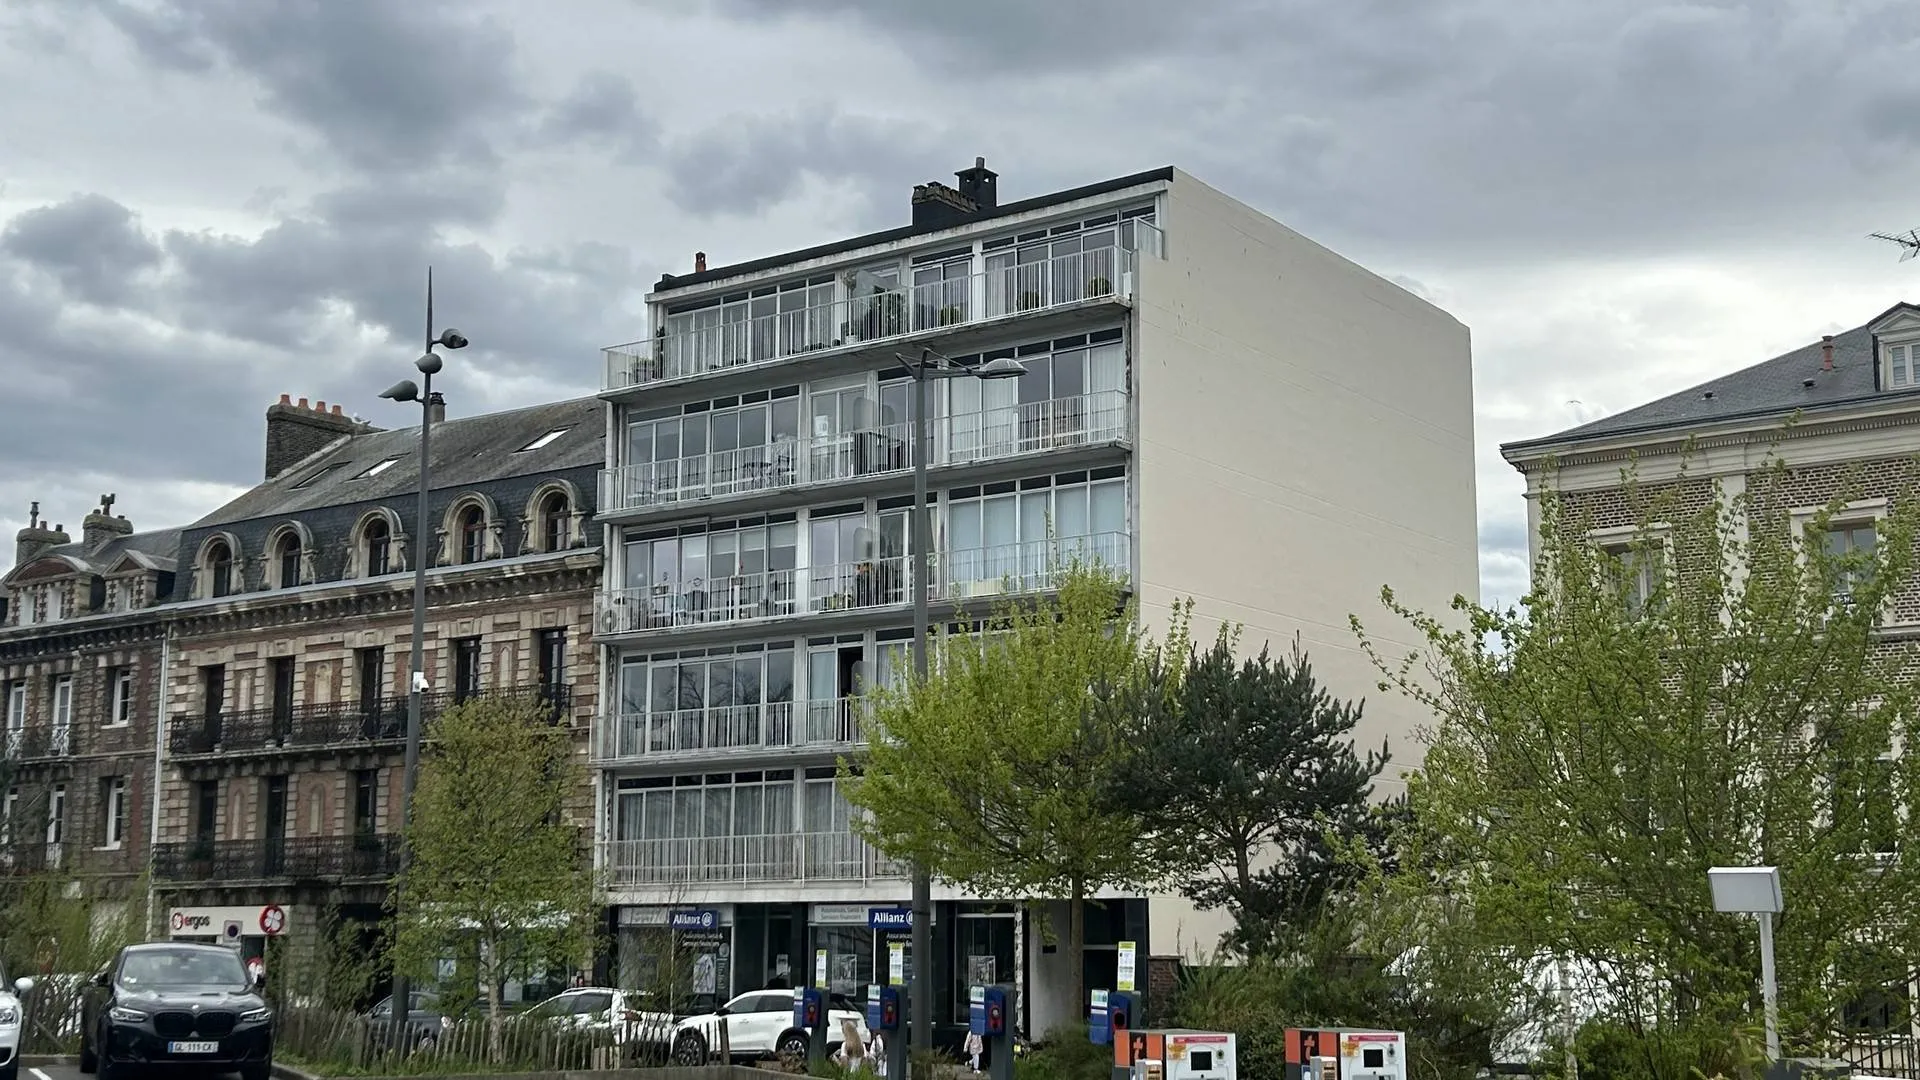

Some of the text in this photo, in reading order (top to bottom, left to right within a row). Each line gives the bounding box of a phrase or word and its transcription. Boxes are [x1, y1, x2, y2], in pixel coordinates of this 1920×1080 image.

[183, 915, 210, 929] ergos
[673, 914, 701, 925] Allianz
[873, 912, 905, 924] Allianz
